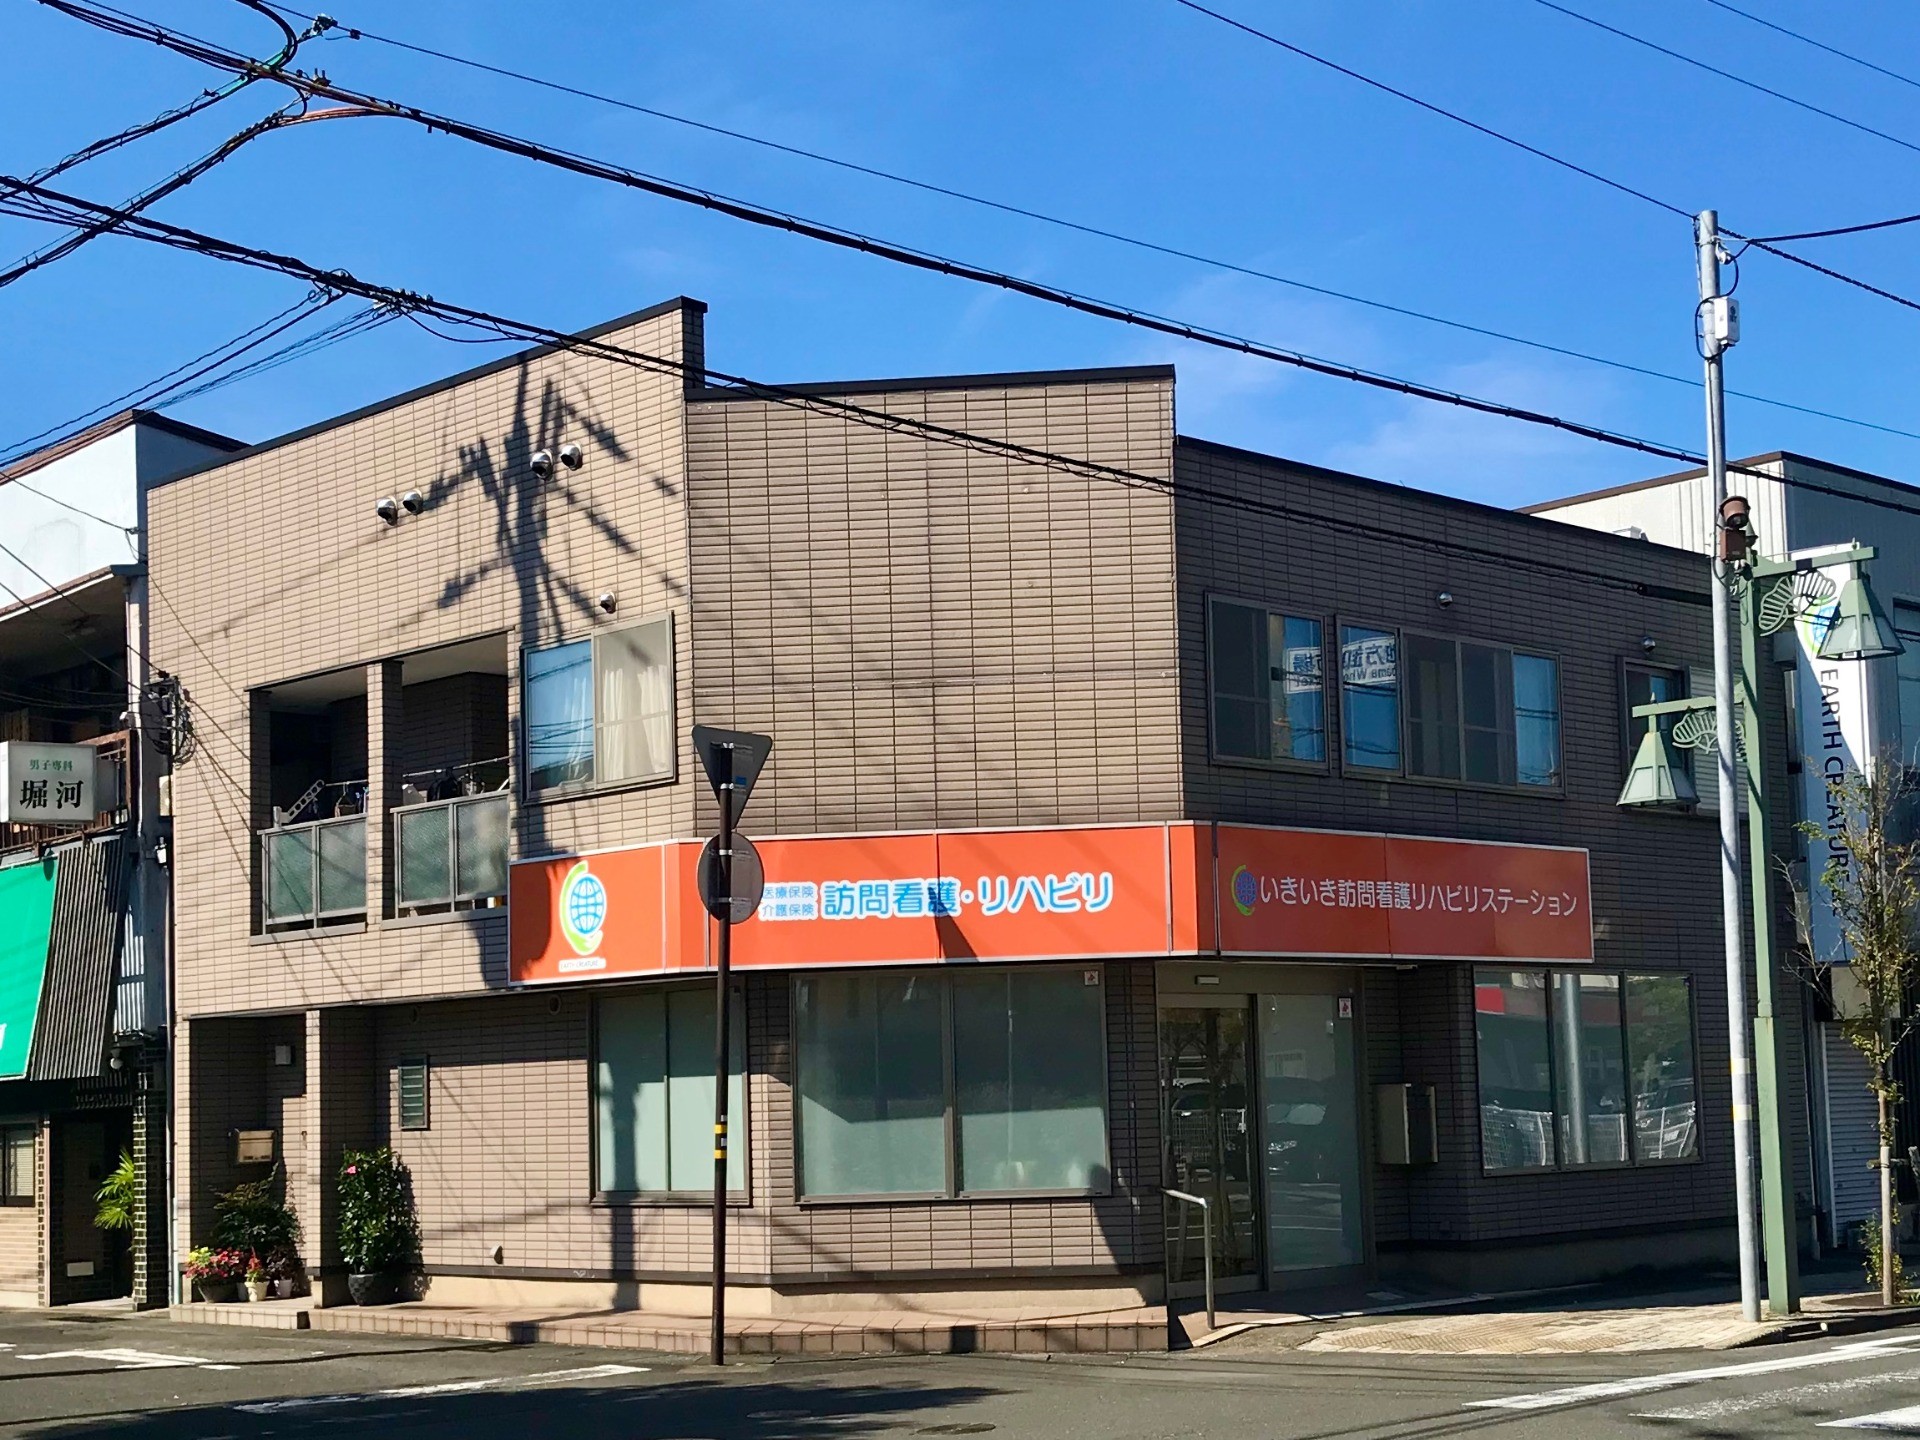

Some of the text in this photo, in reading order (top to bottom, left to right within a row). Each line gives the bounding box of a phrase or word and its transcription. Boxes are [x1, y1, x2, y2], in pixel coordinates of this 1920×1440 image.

[1819, 668, 1843, 750] EARTH
[19, 779, 84, 810] 堀河
[762, 903, 815, 917] 介護保険
[823, 874, 1110, 916] 訪問看護・リハビリ
[1260, 874, 1578, 917] いきいき訪問看護リハビリステーション
